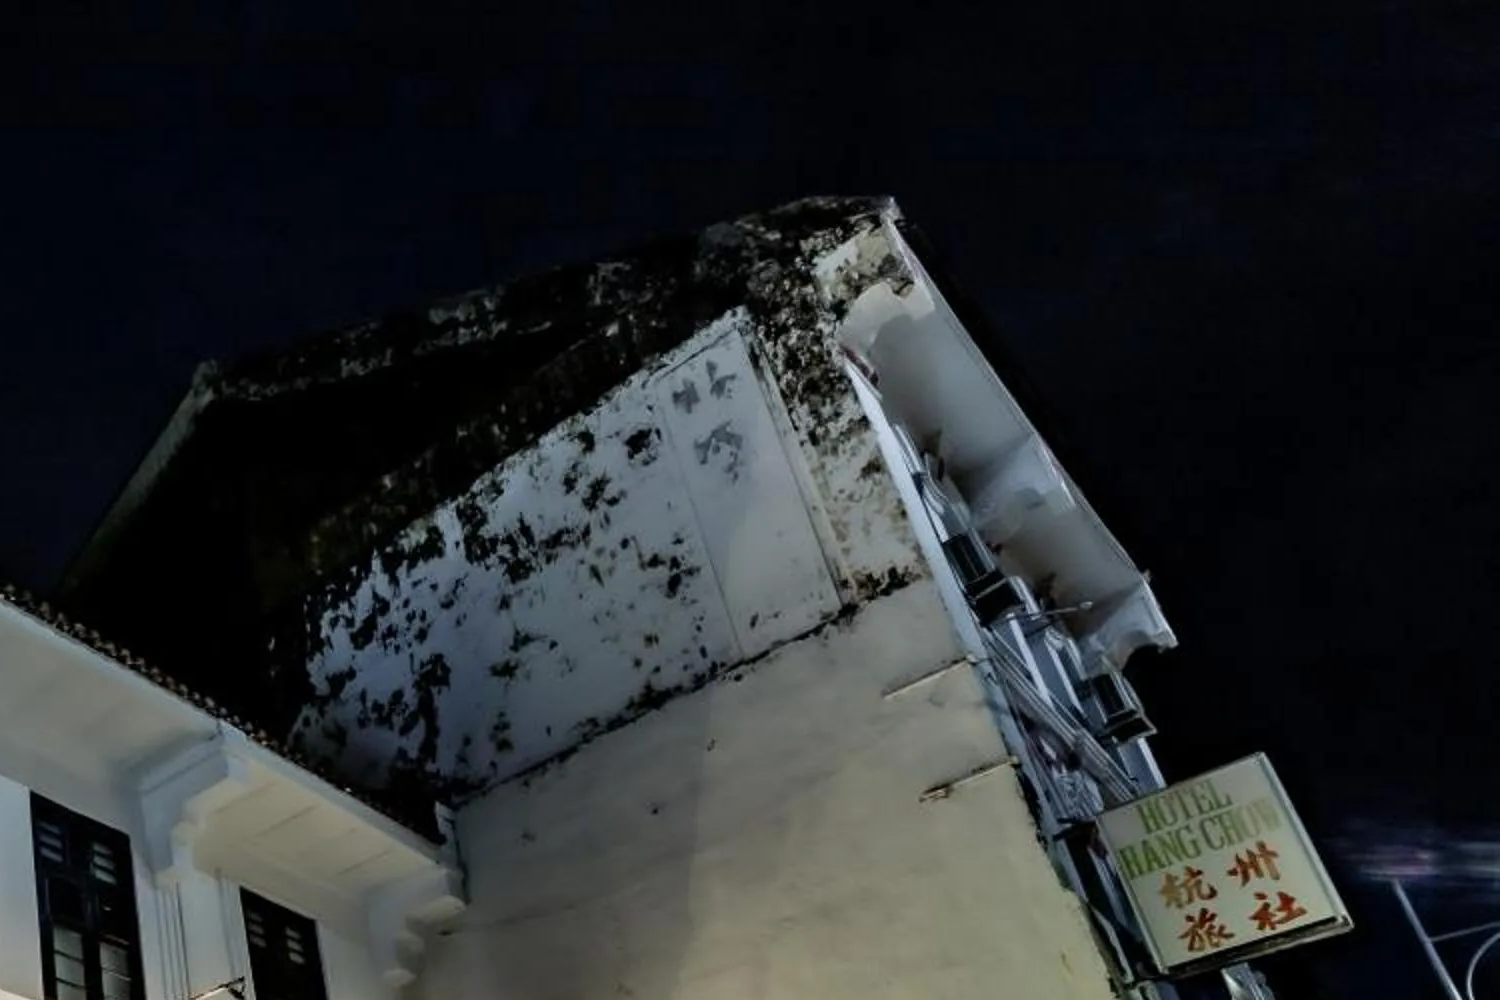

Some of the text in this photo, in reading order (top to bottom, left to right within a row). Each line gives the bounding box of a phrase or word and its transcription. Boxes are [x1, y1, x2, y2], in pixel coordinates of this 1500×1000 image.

[1136, 778, 1233, 834] HOTEL
[1160, 840, 1281, 908] 杭州
[1178, 891, 1308, 952] 旅社
